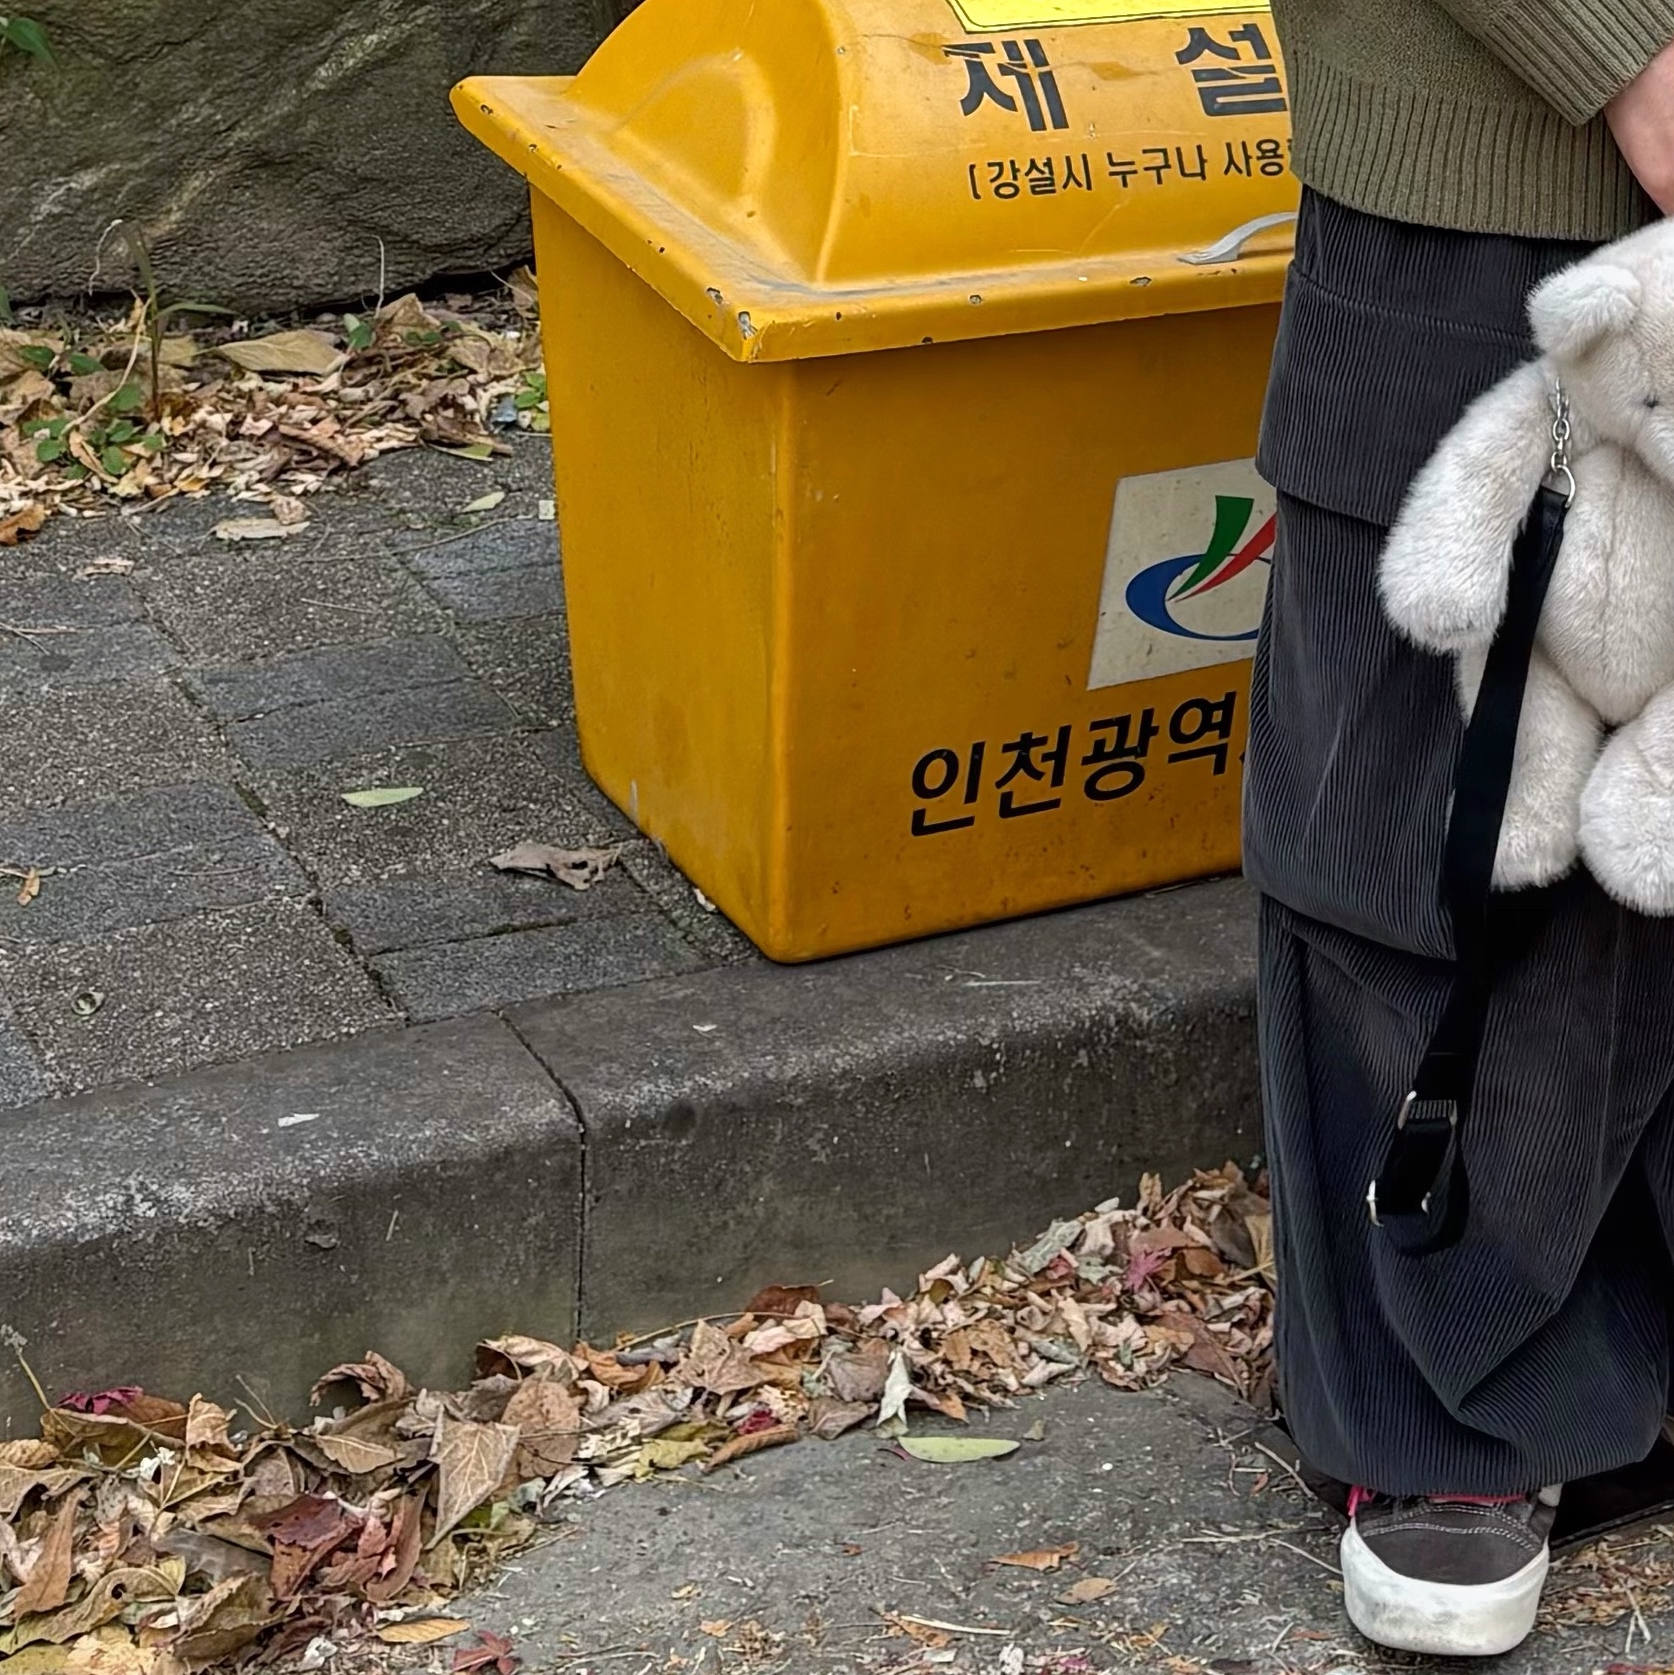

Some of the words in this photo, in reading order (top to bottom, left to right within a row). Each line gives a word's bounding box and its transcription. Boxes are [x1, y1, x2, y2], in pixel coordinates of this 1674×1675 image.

[943, 38, 1070, 132] 제
[1175, 23, 1288, 118] 설
[1106, 143, 1208, 189] 누구나
[1222, 138, 1293, 177] 사용
[910, 690, 1246, 837] 인천광역
